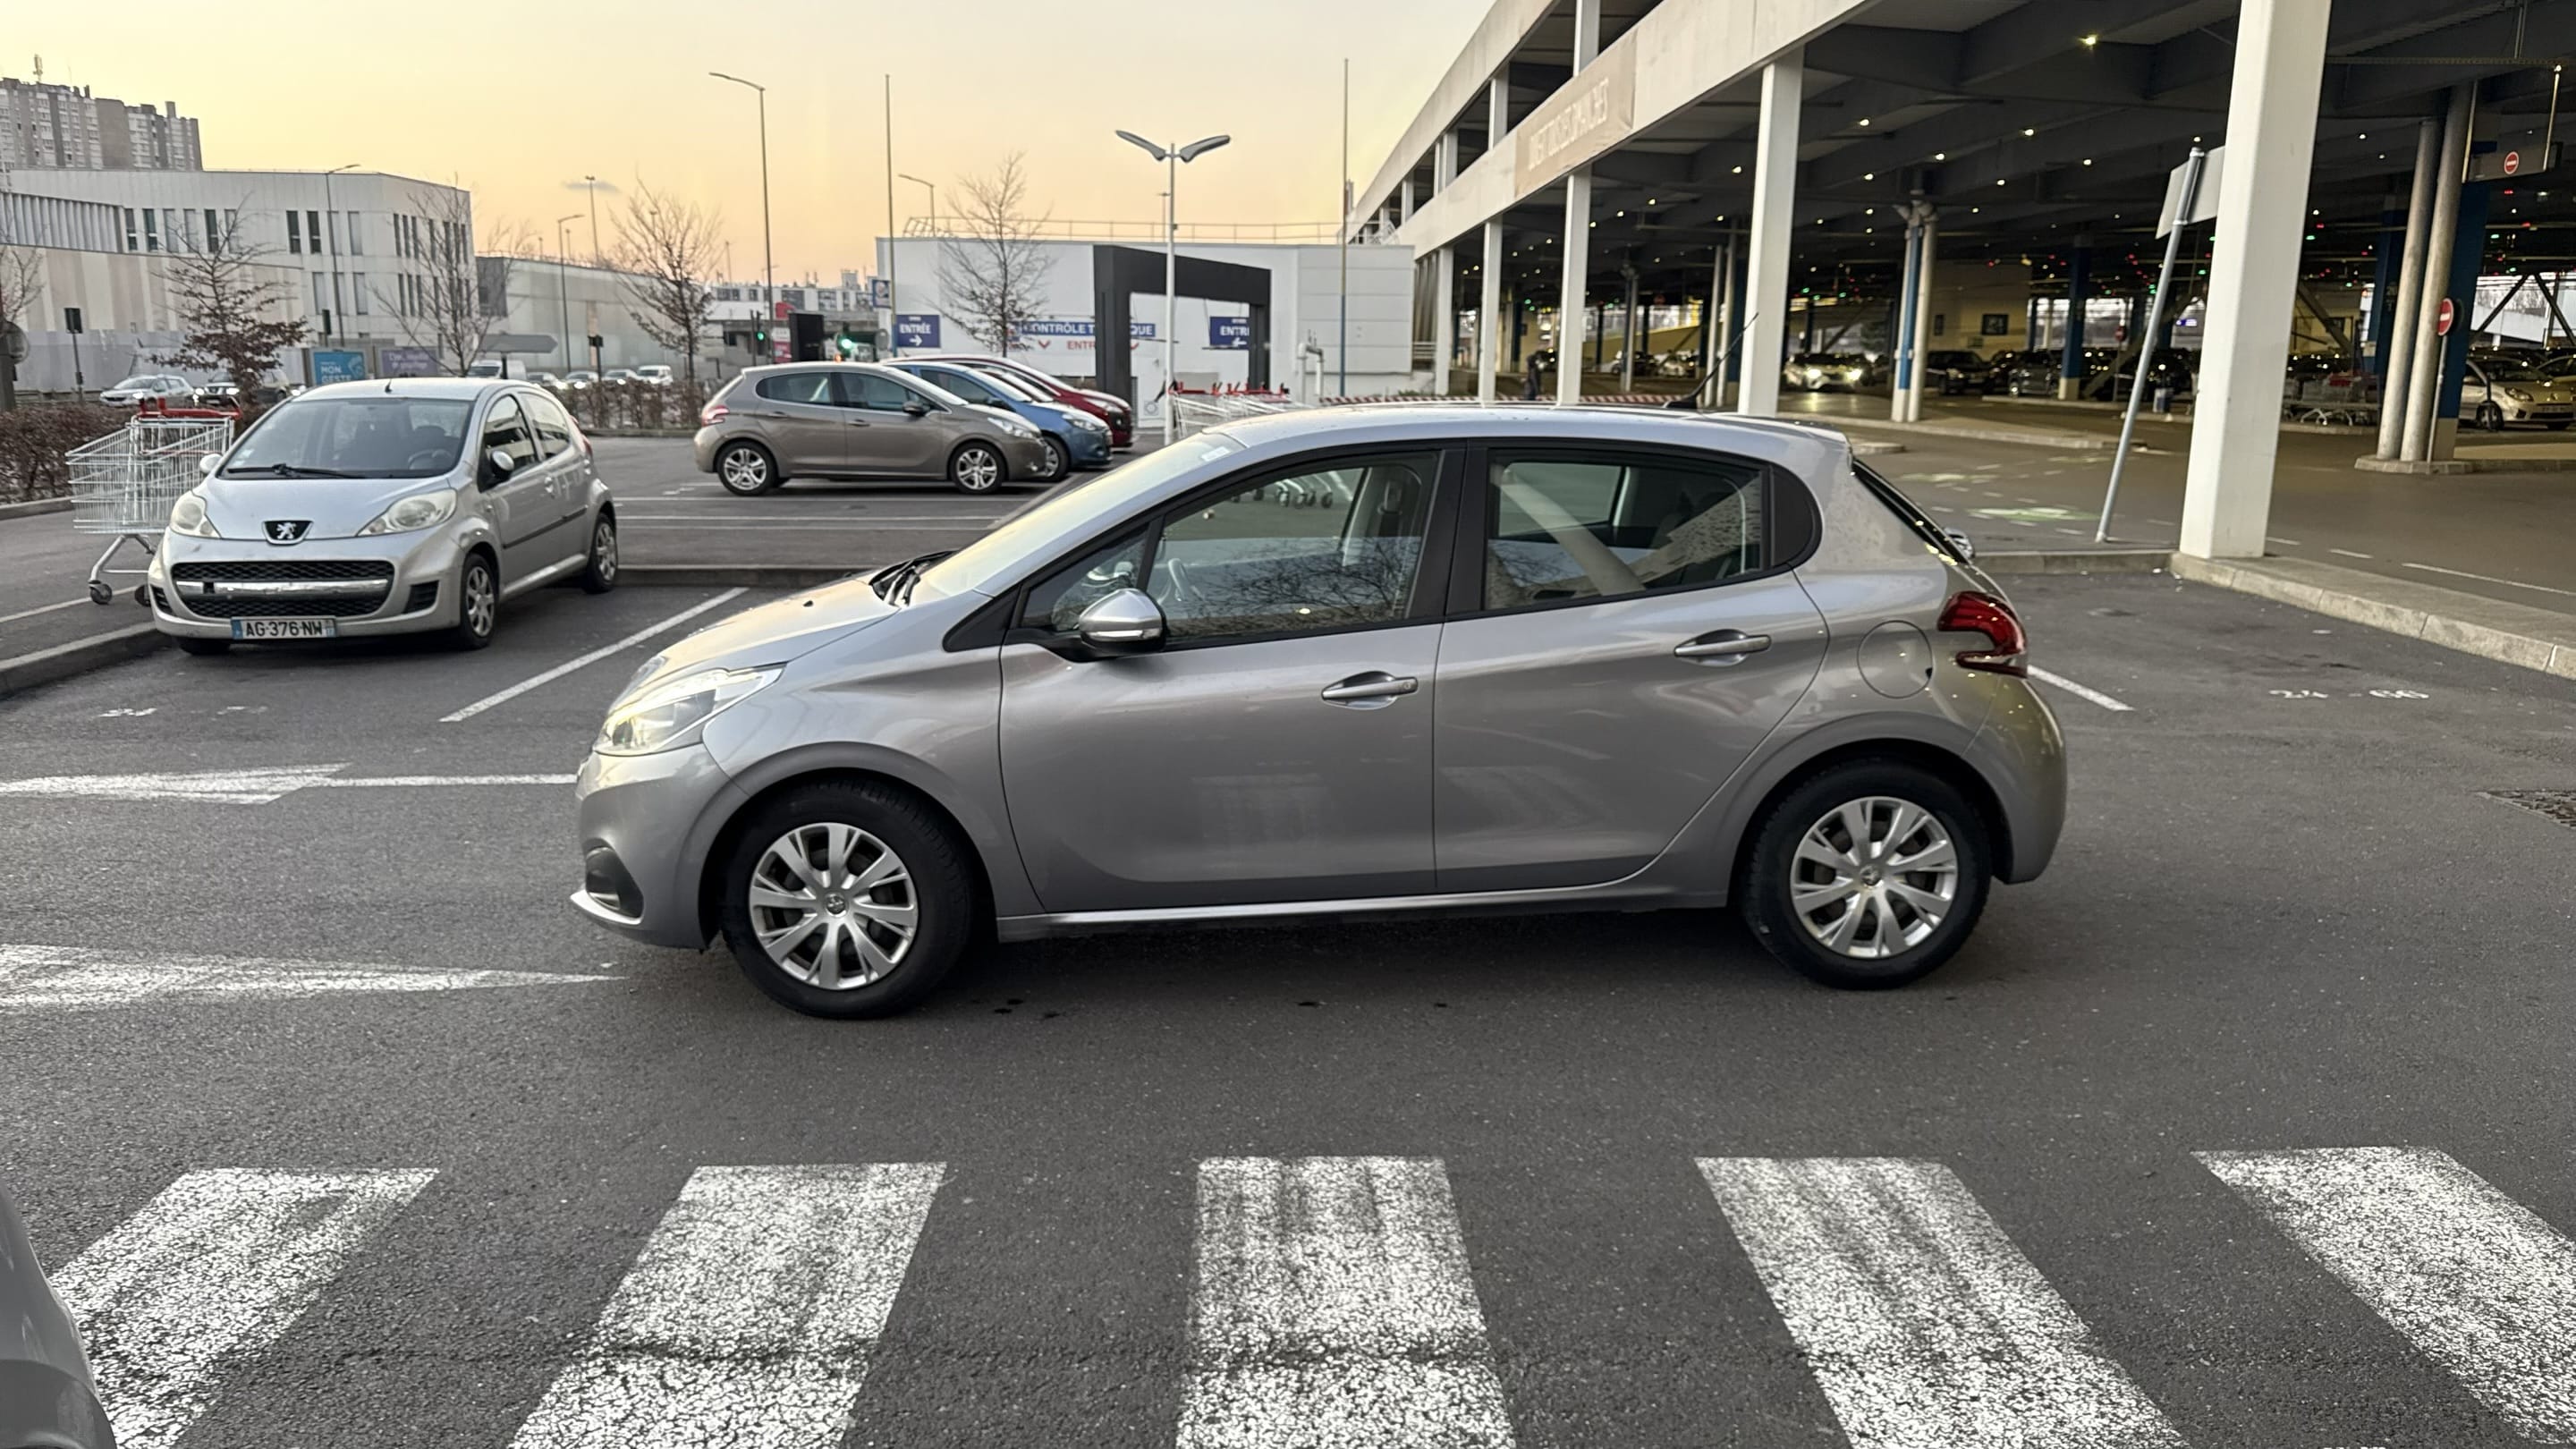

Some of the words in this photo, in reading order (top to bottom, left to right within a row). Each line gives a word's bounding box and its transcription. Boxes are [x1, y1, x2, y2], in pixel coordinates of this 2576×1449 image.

[899, 321, 931, 334] ENTRÉE
[1023, 321, 1085, 334] CONTRÔLE
[1220, 326, 1250, 336] ENTR
[1067, 340, 1096, 351] ENTR
[321, 365, 342, 374] MON
